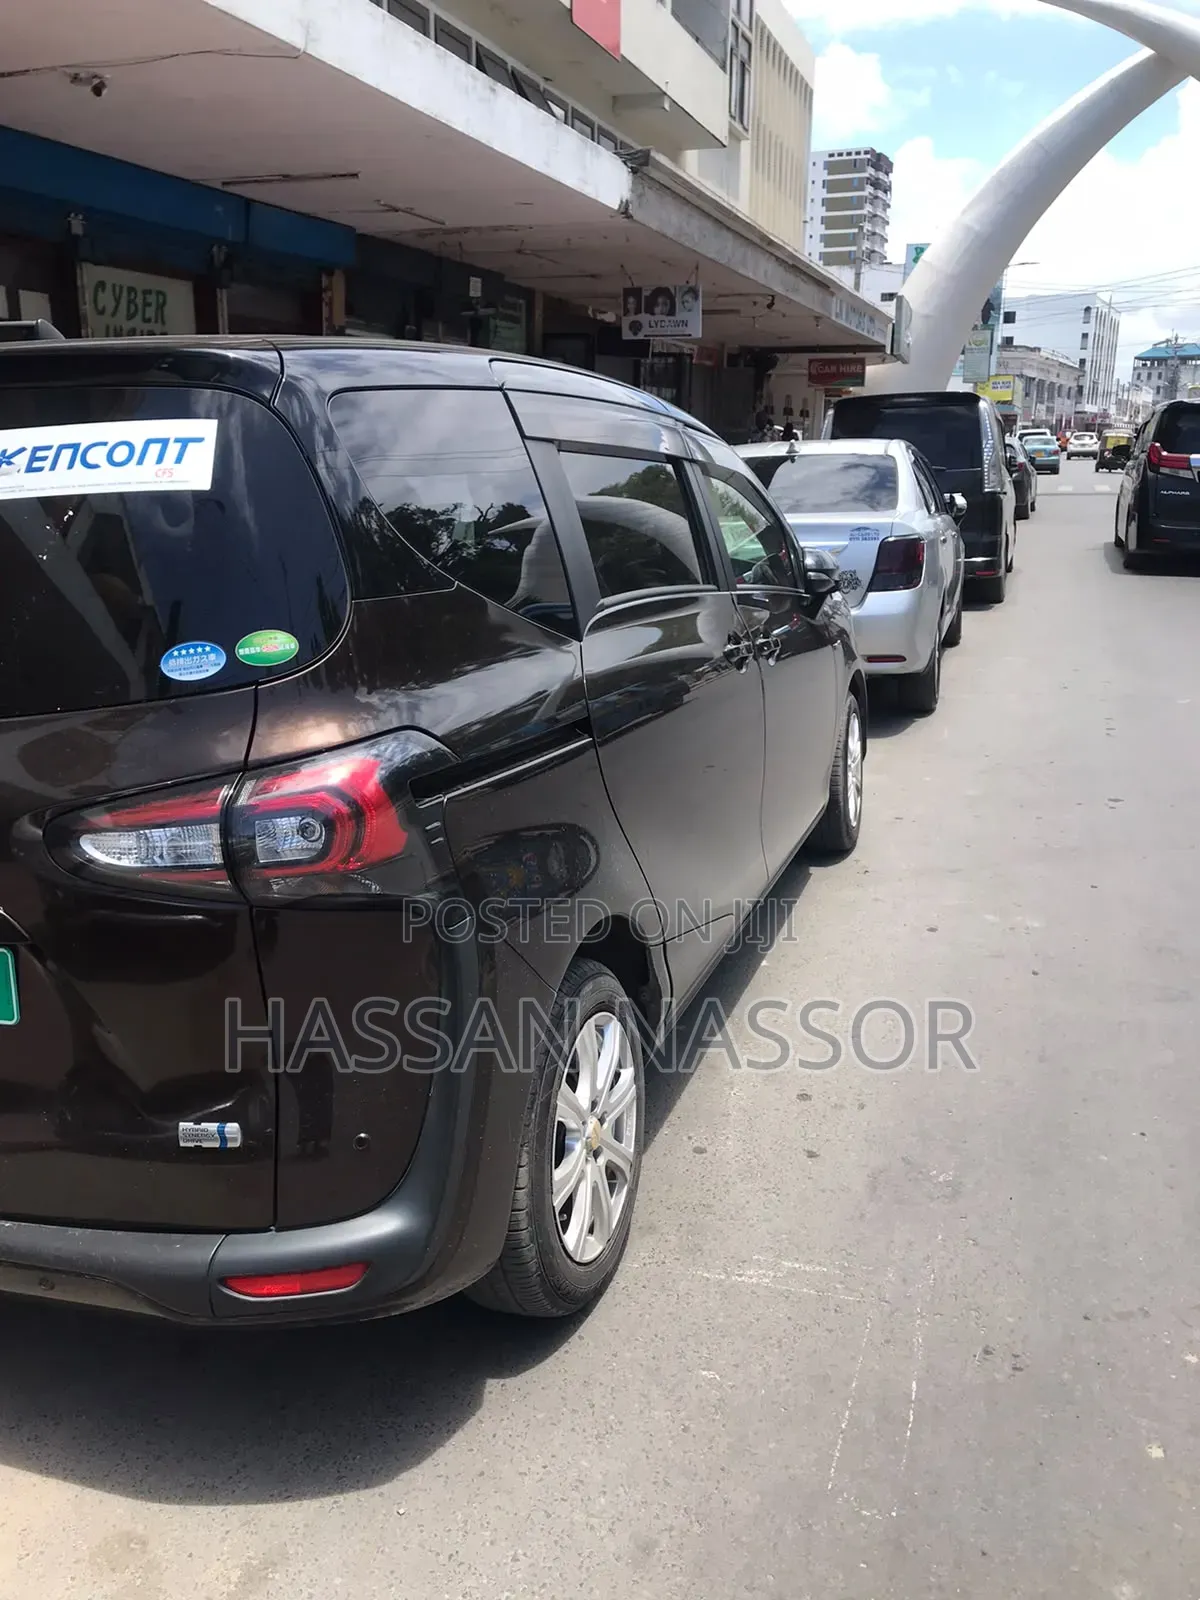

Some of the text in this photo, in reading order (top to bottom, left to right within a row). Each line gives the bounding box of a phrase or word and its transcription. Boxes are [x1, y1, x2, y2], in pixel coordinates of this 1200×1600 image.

[93, 280, 168, 326] CYBER
[648, 319, 688, 329] LYDAWN
[817, 364, 863, 373] CAR HIRE
[155, 468, 174, 478] CFS
